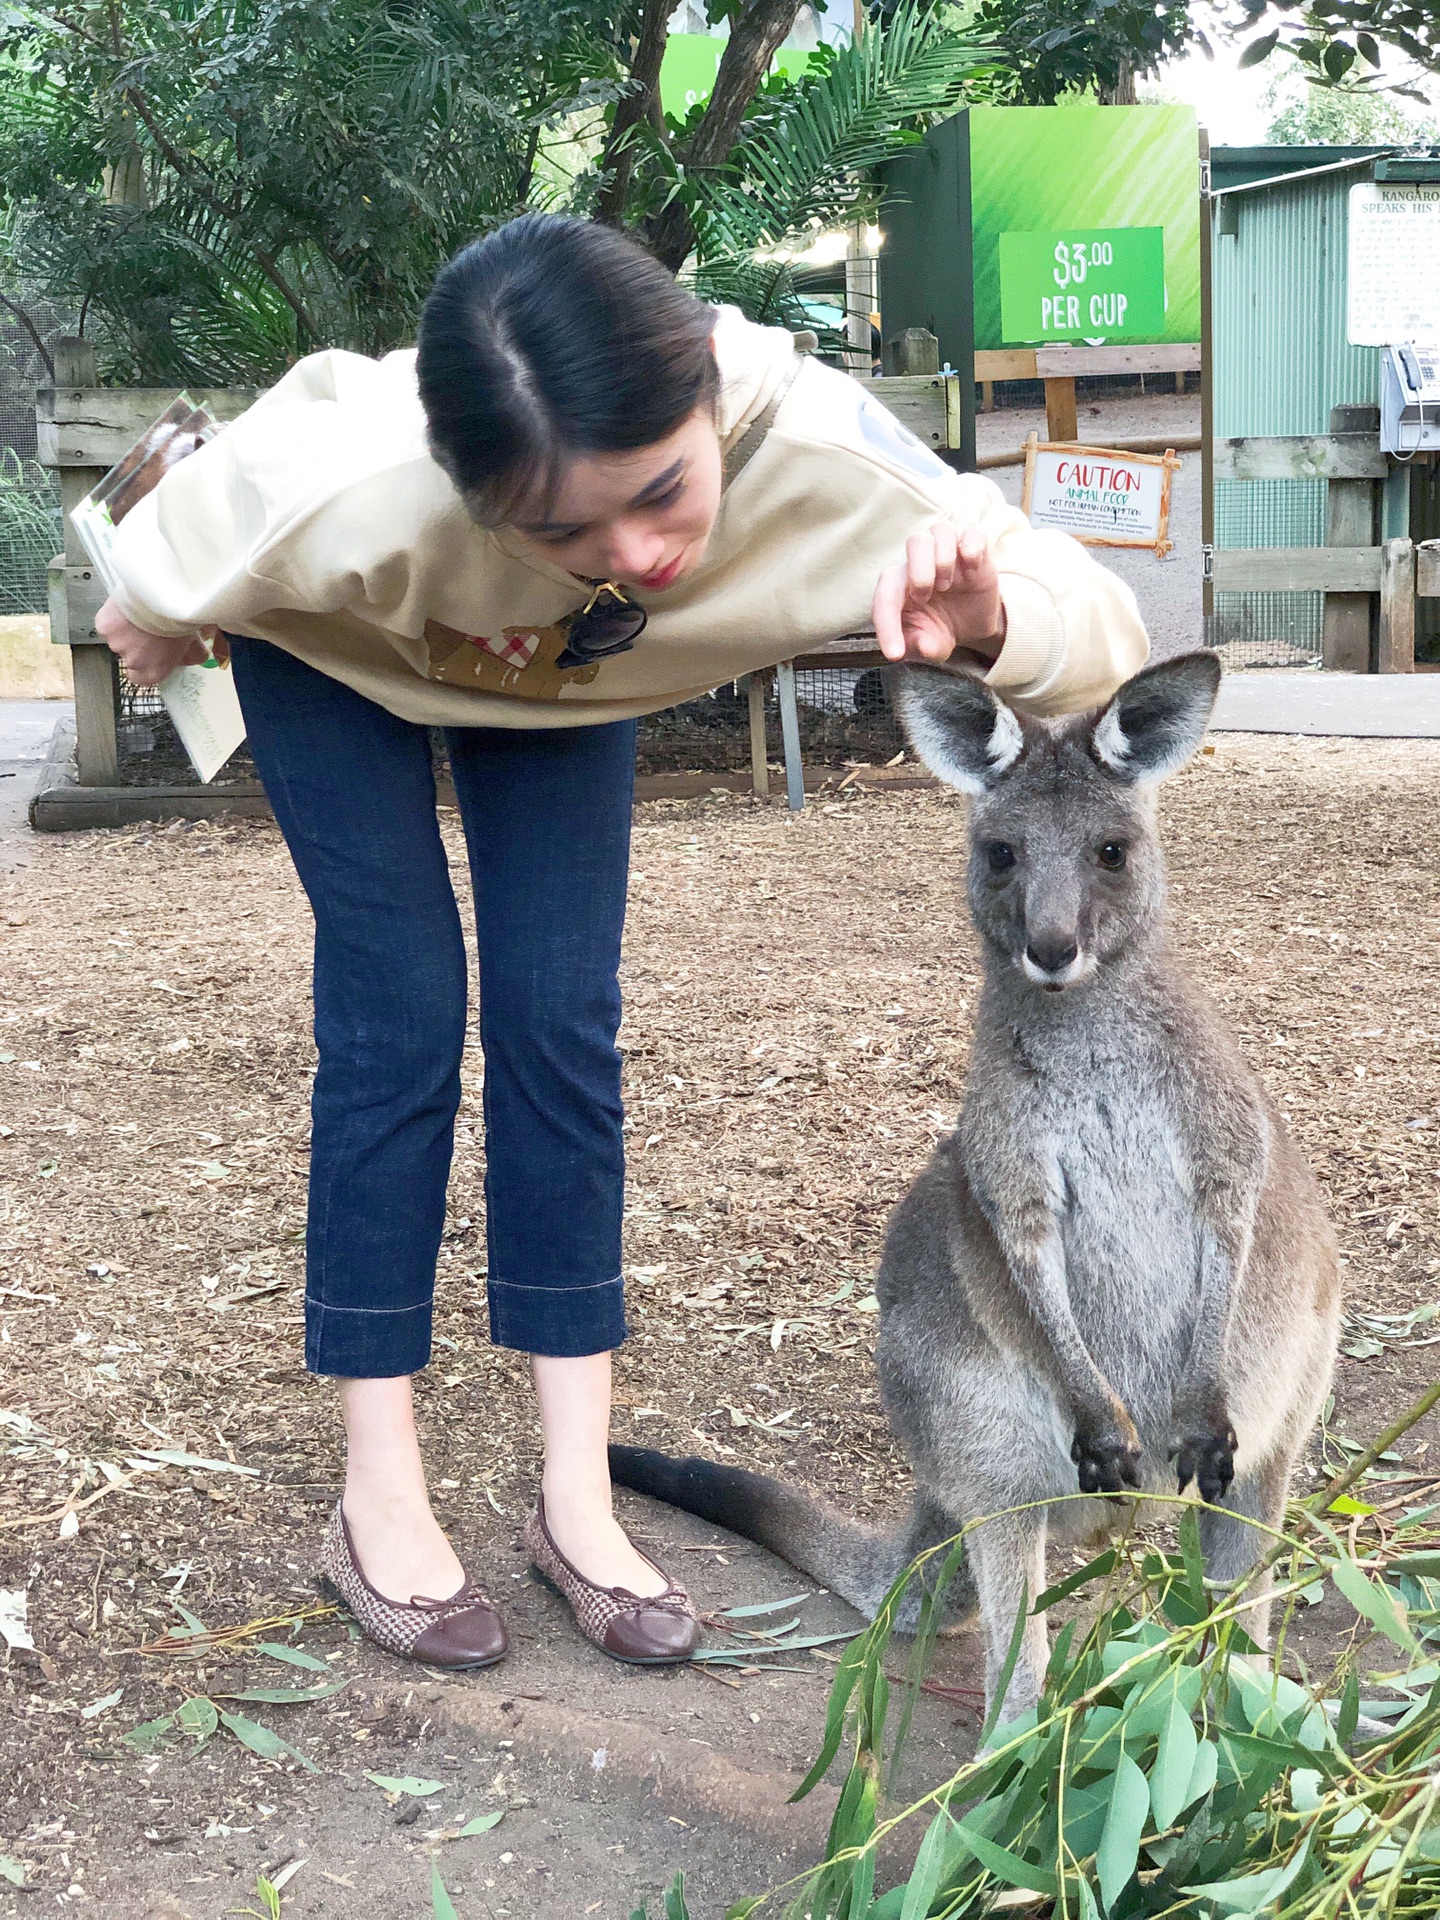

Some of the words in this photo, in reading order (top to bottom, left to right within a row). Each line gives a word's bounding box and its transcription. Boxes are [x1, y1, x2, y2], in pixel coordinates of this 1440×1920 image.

[1382, 191, 1440, 202] KANGARO
[1361, 203, 1406, 213] SPEAKS
[1412, 203, 1432, 213] HIS
[1053, 240, 1113, 290] $3.00
[1041, 295, 1081, 330] PER
[1089, 293, 1128, 327] CUP
[1056, 462, 1141, 492] CAUTION
[1048, 499, 1063, 507] NOT
[1066, 487, 1098, 502] ANIMAL
[1103, 491, 1129, 505] FOOD
